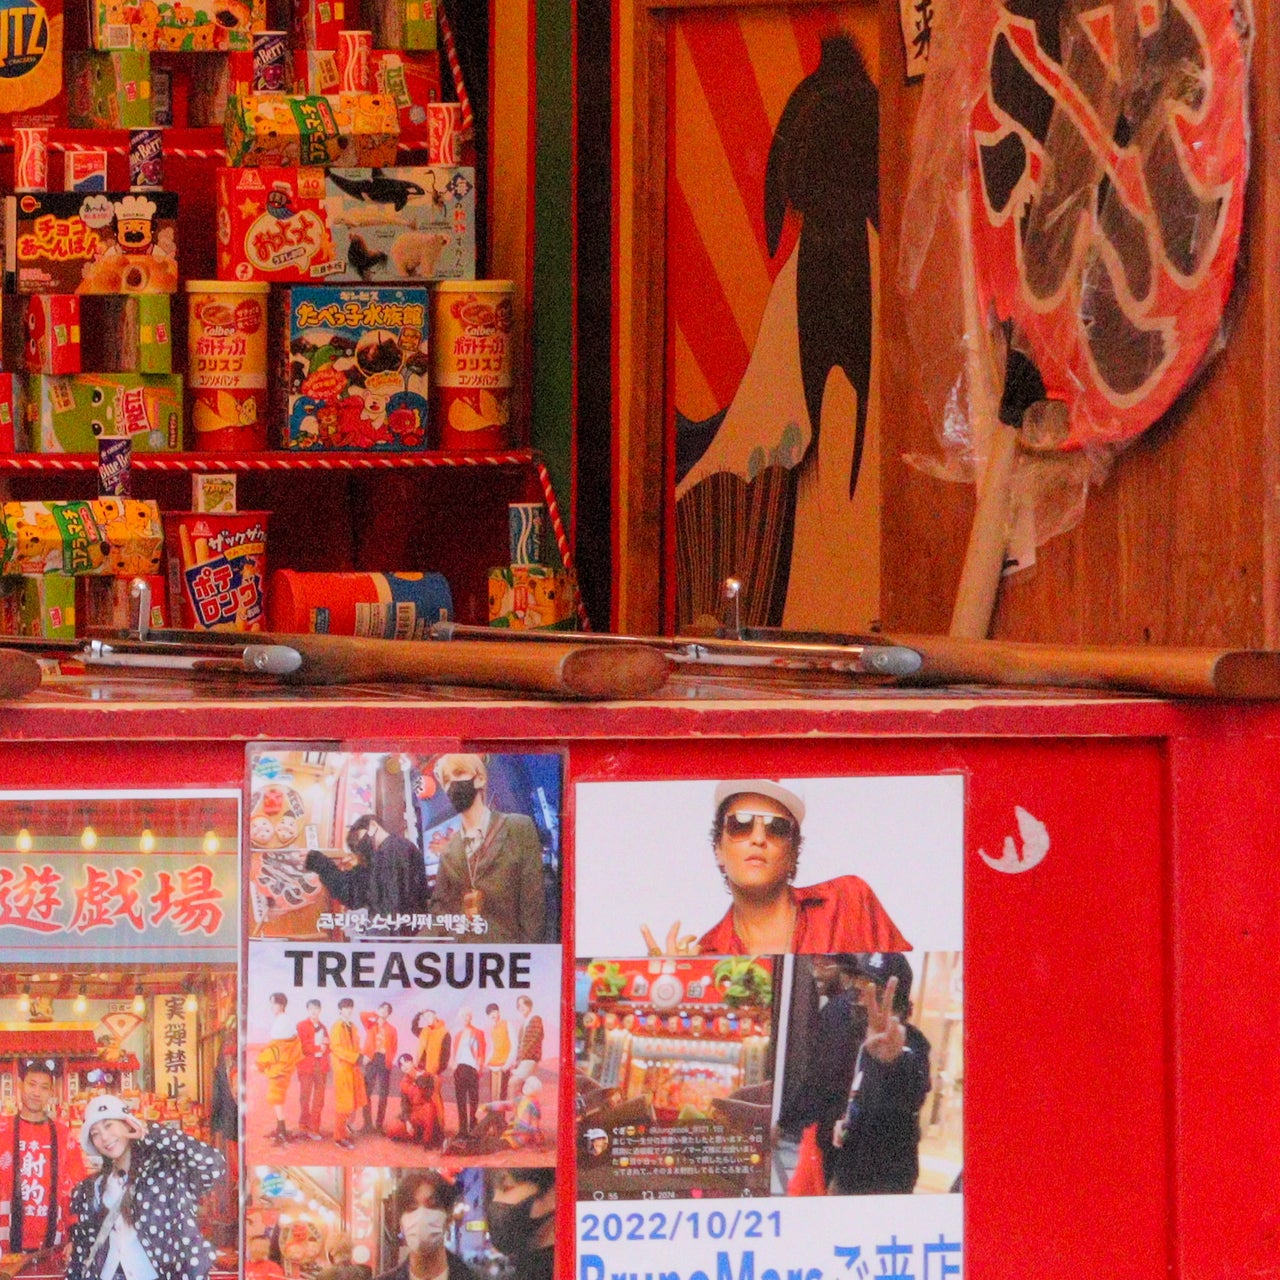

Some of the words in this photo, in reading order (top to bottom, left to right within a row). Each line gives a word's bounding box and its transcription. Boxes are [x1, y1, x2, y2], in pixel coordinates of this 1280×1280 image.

[39, 217, 86, 239] チョコ
[252, 216, 316, 260] おっとっと
[298, 304, 423, 327] たべっ子水族館
[193, 566, 233, 601] ポテ
[200, 578, 260, 624] ロング
[285, 951, 531, 989] TREASURE
[164, 995, 187, 1100] 実弾禁止
[20, 1153, 47, 1205] 射的
[581, 1210, 781, 1241] 2022/10/21
